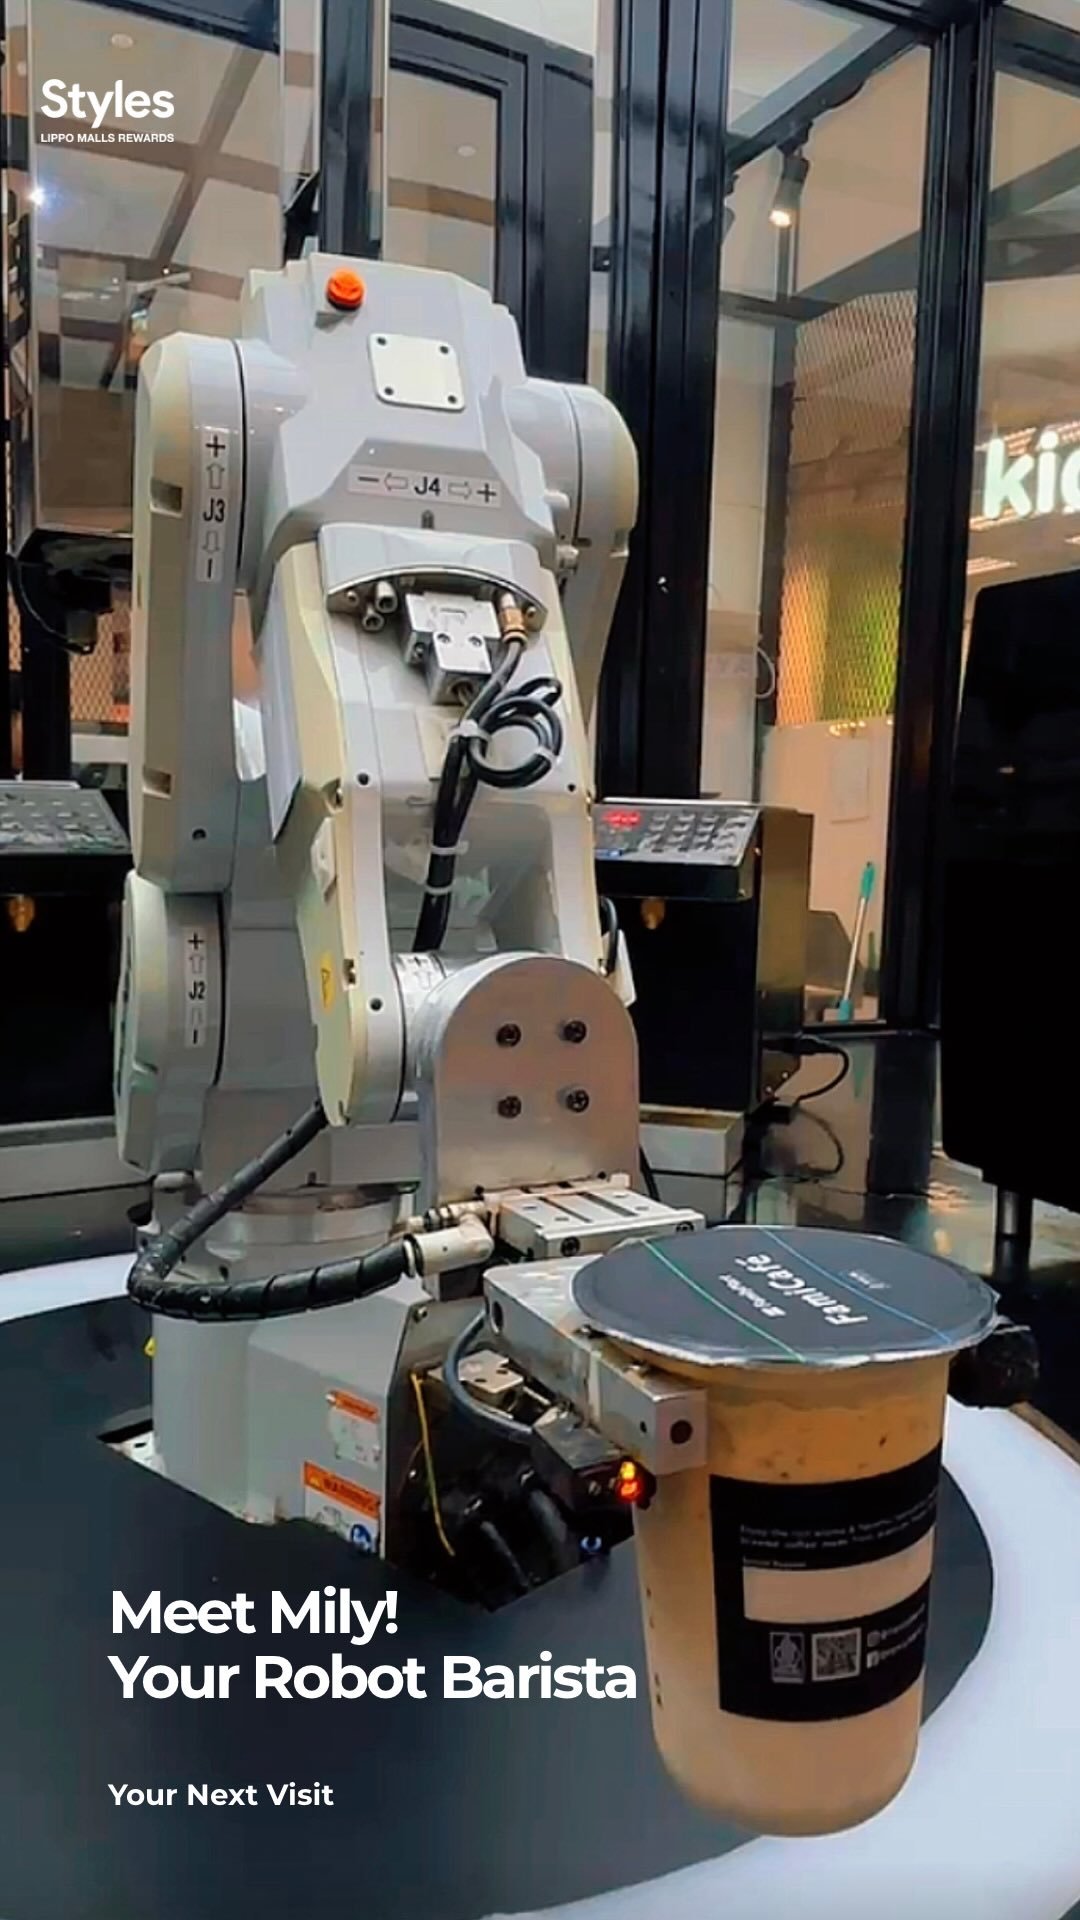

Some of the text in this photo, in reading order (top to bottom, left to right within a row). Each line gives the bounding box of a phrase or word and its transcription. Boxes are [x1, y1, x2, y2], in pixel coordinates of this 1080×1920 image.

[414, 477, 441, 496] J4
[203, 498, 225, 522] J3
[188, 981, 206, 1000] J2
